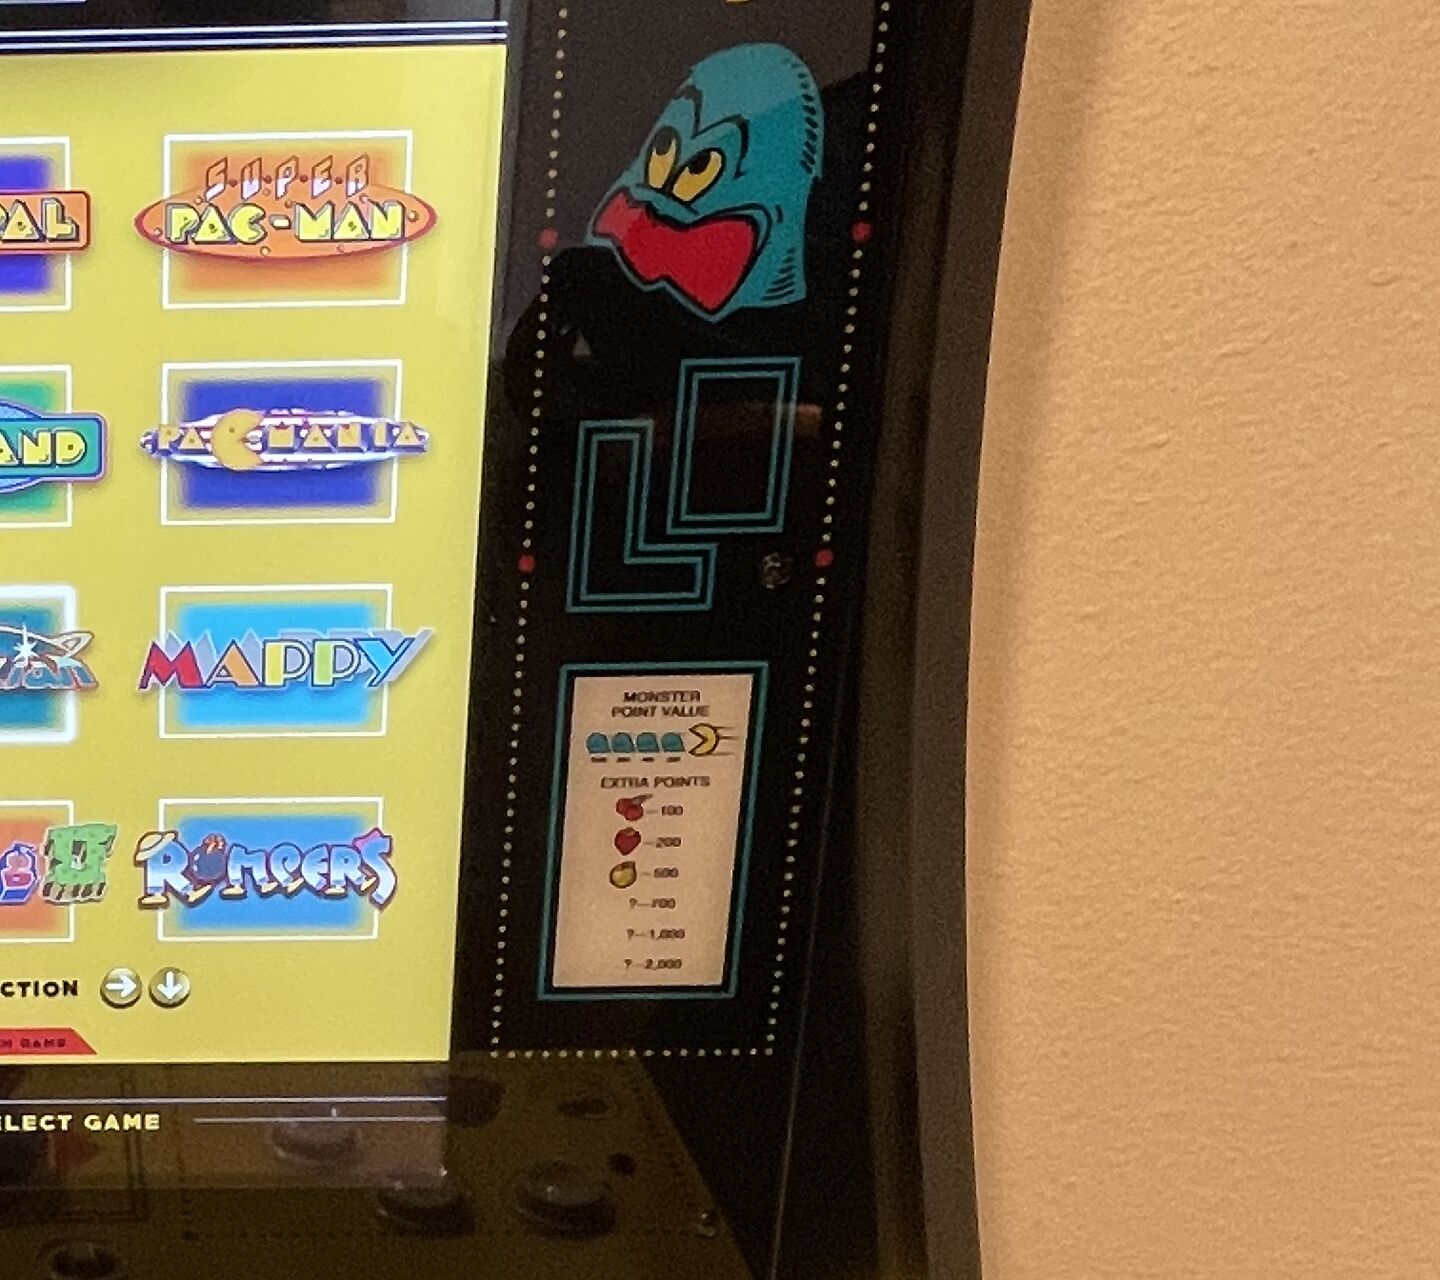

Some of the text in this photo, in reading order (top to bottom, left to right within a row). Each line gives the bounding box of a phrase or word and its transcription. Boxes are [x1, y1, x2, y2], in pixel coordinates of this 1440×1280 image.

[166, 200, 406, 244] PAC-MAN
[138, 632, 426, 691] MAPPY
[623, 690, 700, 702] MONSTER
[612, 706, 710, 717] POINT VALUE
[84, 1114, 161, 1132] GAME
